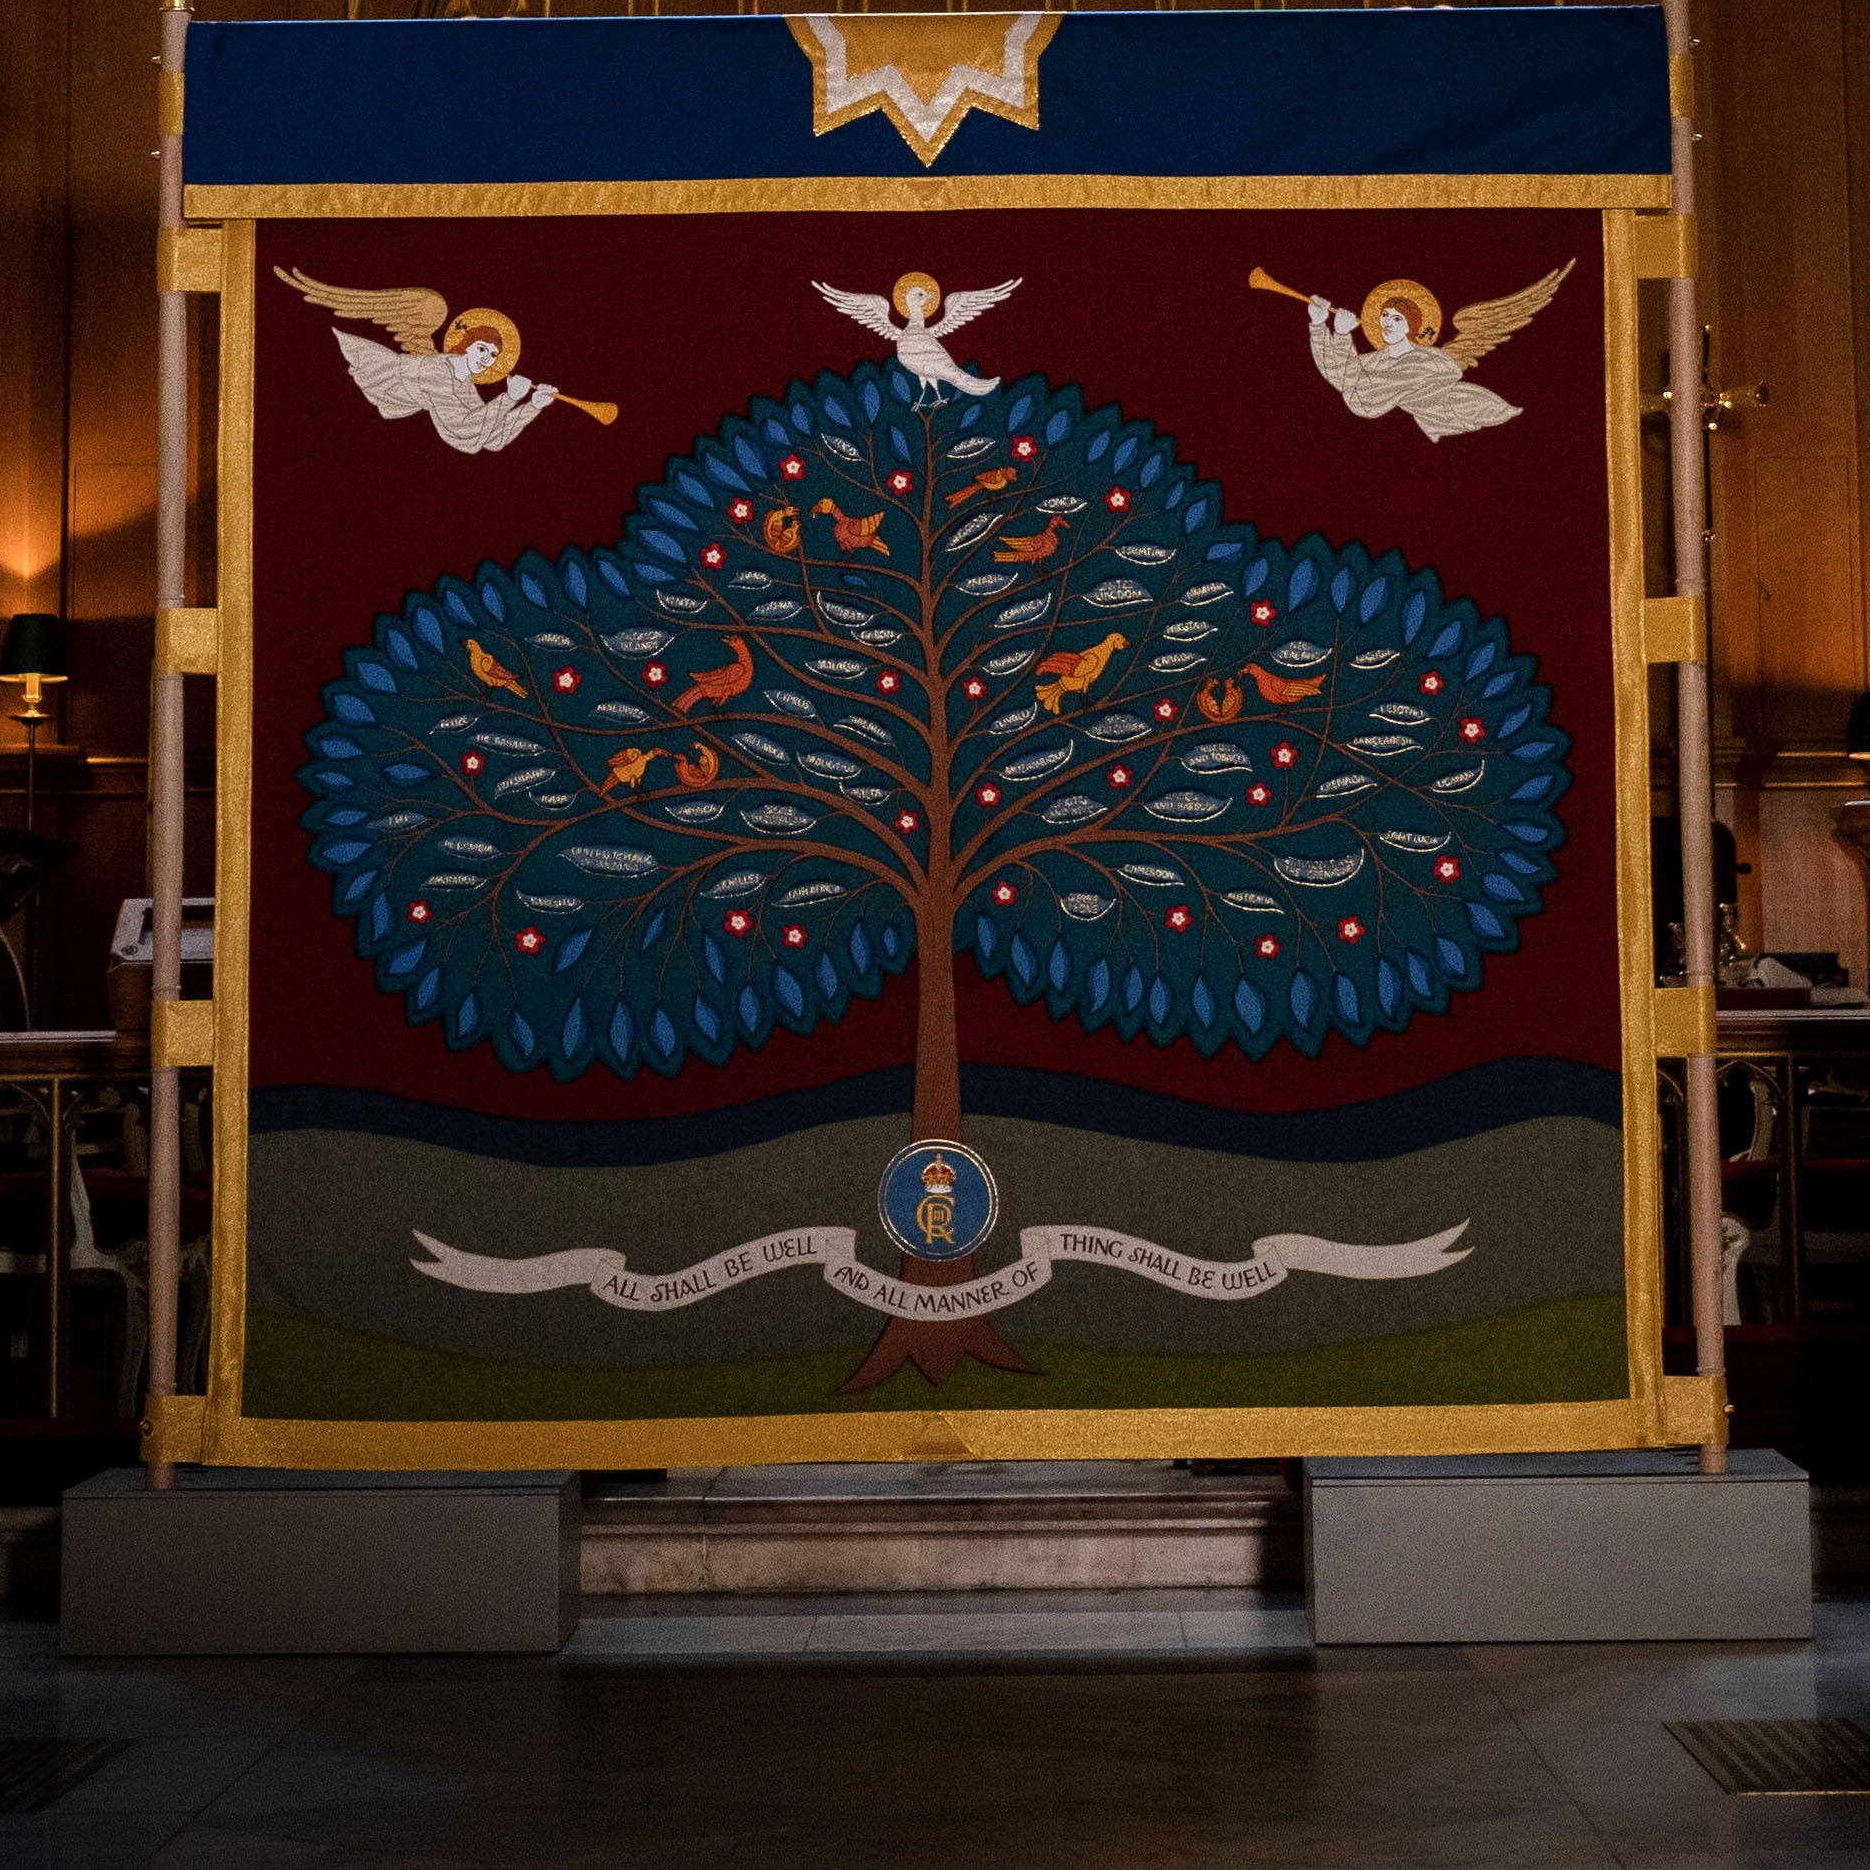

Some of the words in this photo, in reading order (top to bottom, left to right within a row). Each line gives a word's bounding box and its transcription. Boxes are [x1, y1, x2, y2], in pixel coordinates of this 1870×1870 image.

[603, 1275, 640, 1302] ALL
[650, 1270, 717, 1302] SHALL
[724, 1251, 754, 1278] BE
[763, 1236, 817, 1263] WELL
[833, 1266, 869, 1291] AND
[874, 1284, 907, 1310] ALL
[914, 1281, 1010, 1313] MANNER
[1012, 1261, 1039, 1288] OF
[1060, 1233, 1123, 1258] THING
[1129, 1247, 1181, 1280] SHALL
[1187, 1266, 1216, 1289] BE
[1222, 1261, 1277, 1291] WELL
